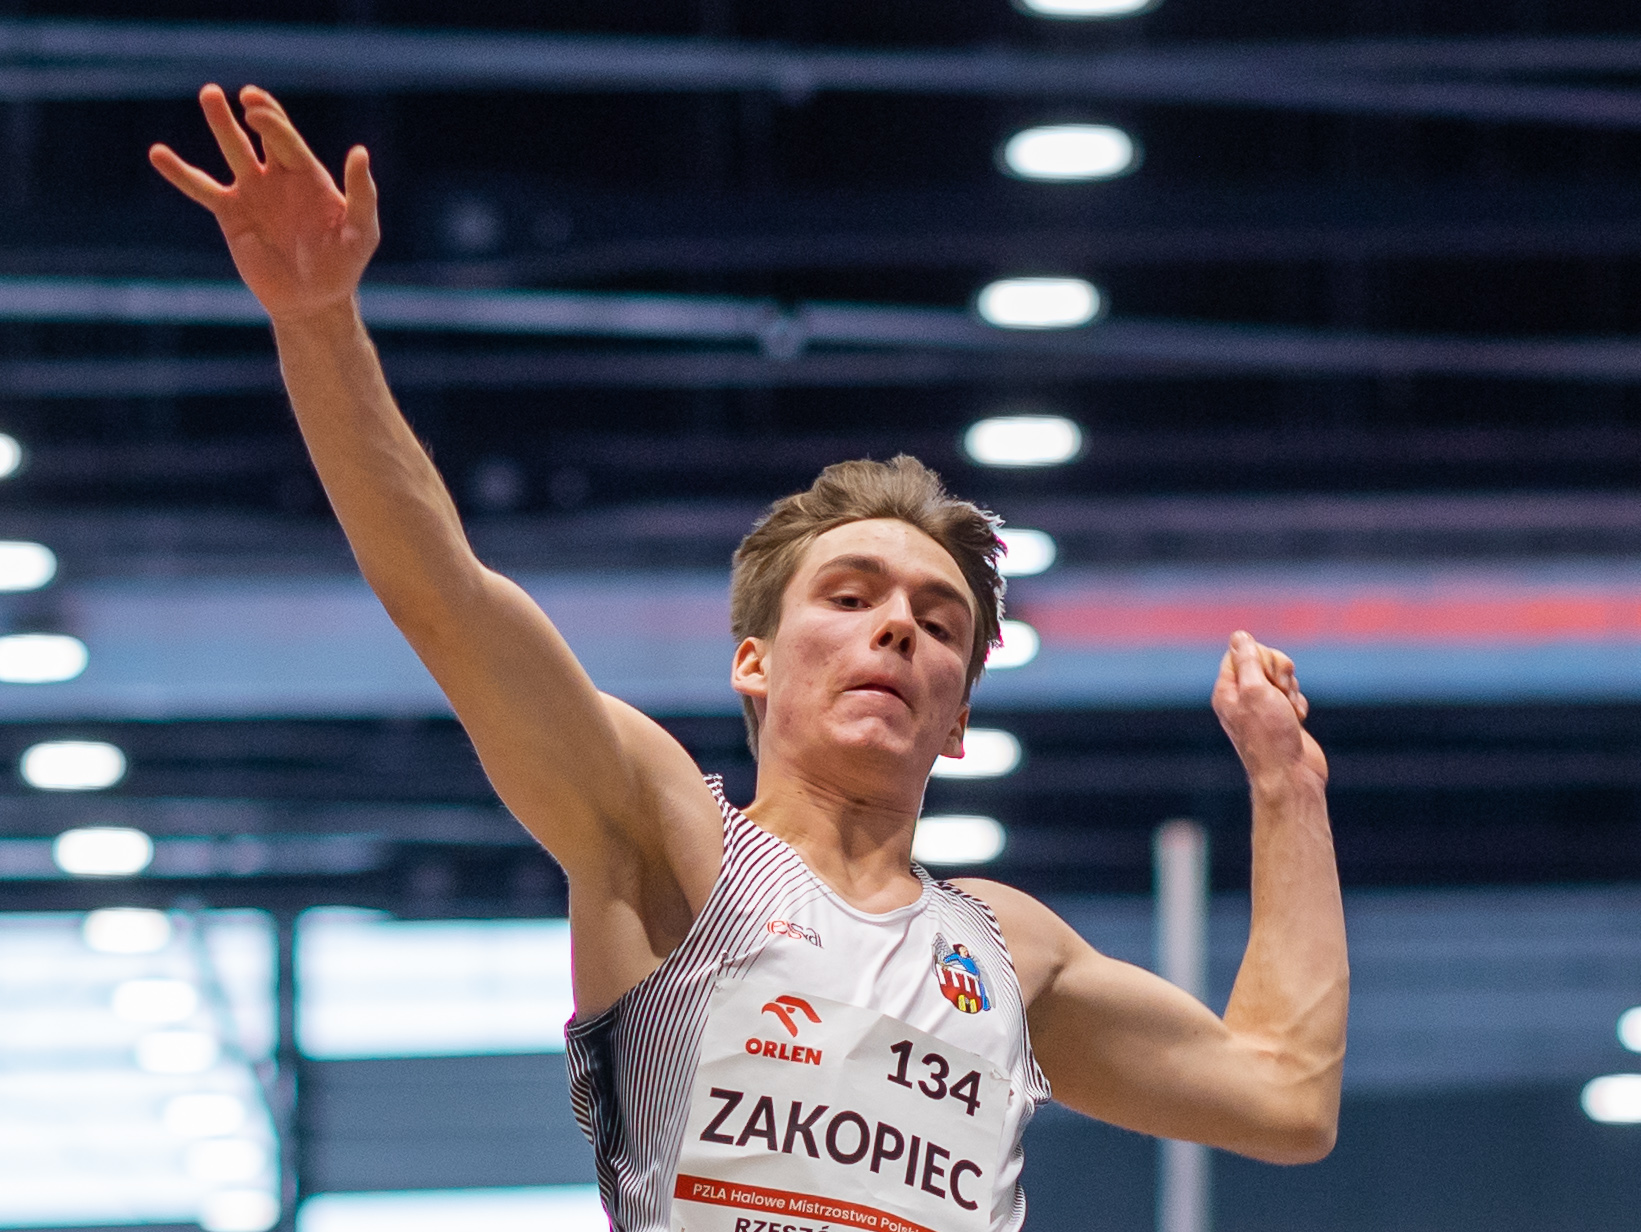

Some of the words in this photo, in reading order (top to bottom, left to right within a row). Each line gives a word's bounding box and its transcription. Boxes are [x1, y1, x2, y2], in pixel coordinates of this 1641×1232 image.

[745, 1037, 822, 1066] ORLEN
[886, 1039, 982, 1117] 134
[699, 1086, 983, 1211] ZAKOPIEC
[692, 1182, 727, 1200] PZLA
[730, 1189, 786, 1209] Halowe
[788, 1198, 877, 1226] Mistrzostwa
